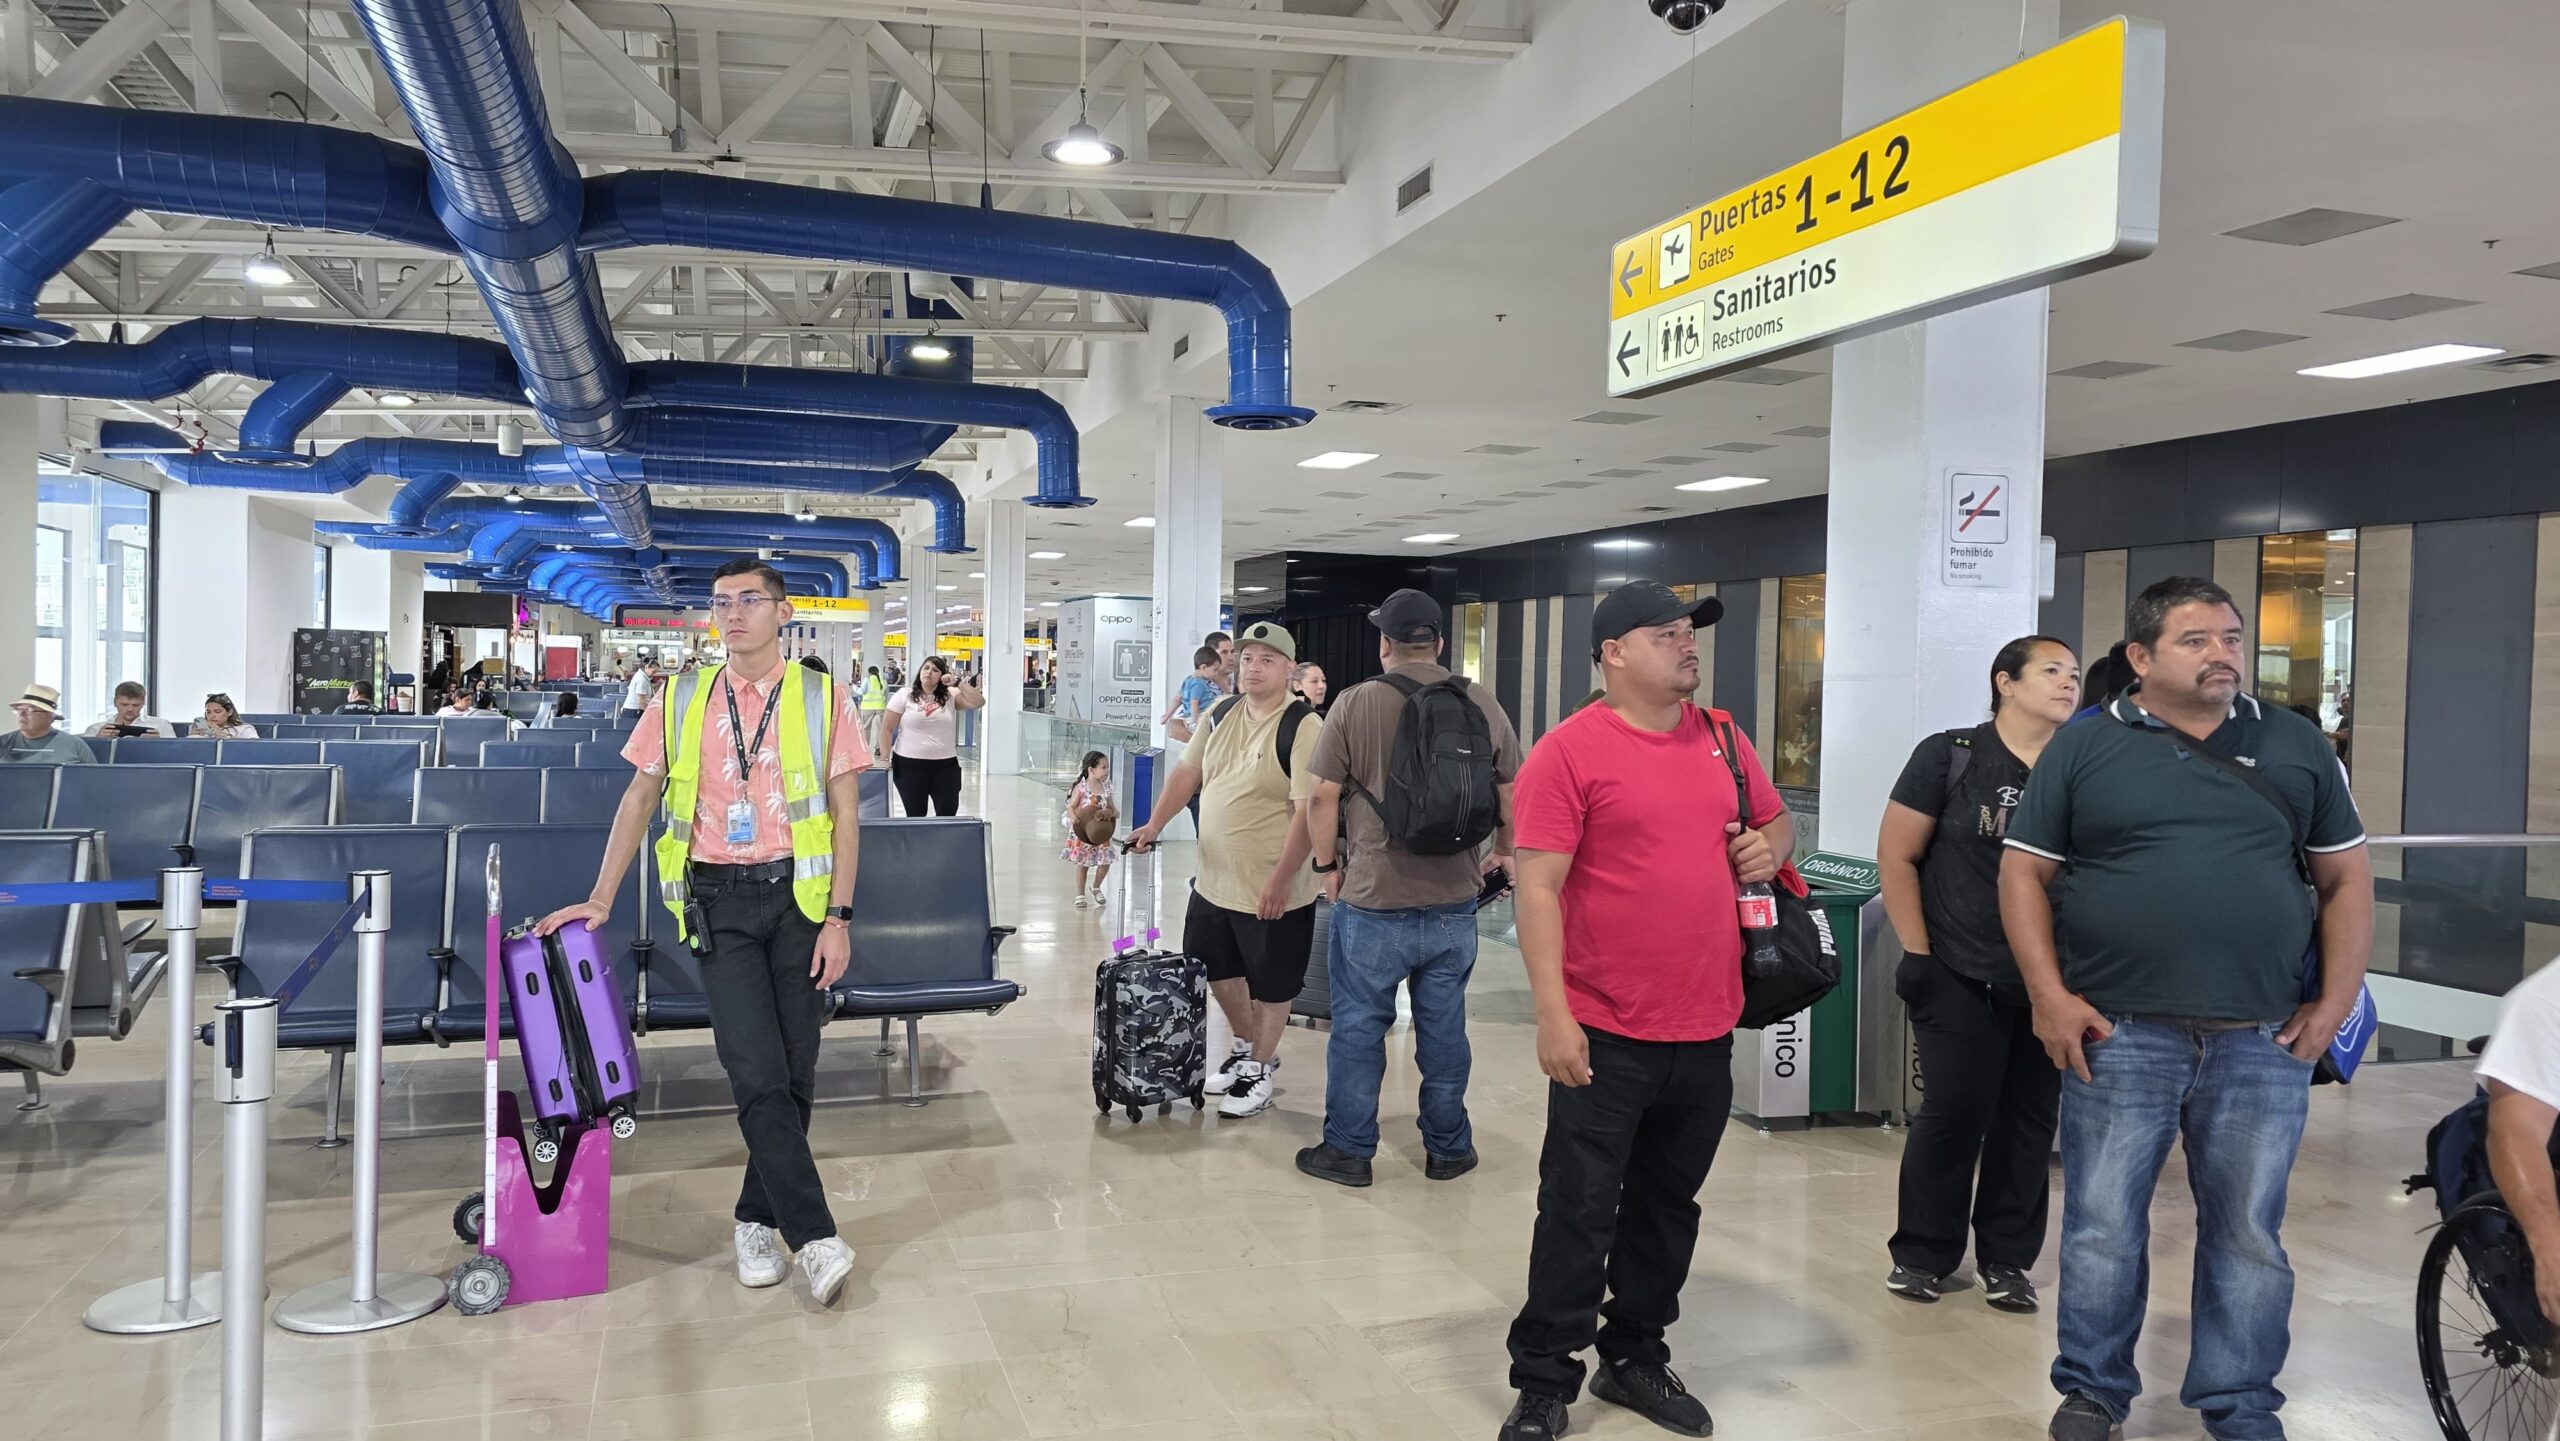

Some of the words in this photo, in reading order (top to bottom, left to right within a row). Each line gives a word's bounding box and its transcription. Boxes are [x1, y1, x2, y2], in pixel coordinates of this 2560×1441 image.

[1699, 183, 1786, 240] Puertas
[1795, 135, 1911, 234] 1-12
[1698, 244, 1734, 272] Gates
[1712, 257, 1837, 321] Sanitarios
[1712, 315, 1784, 352] Restrooms
[1950, 547, 1993, 557] Prohibido
[1950, 559, 1977, 569] fumar
[813, 599, 837, 607] 1-12
[1098, 695, 1122, 704] OPPO
[1123, 696, 1140, 704] Find
[1804, 859, 1869, 881] ORGÁNICO
